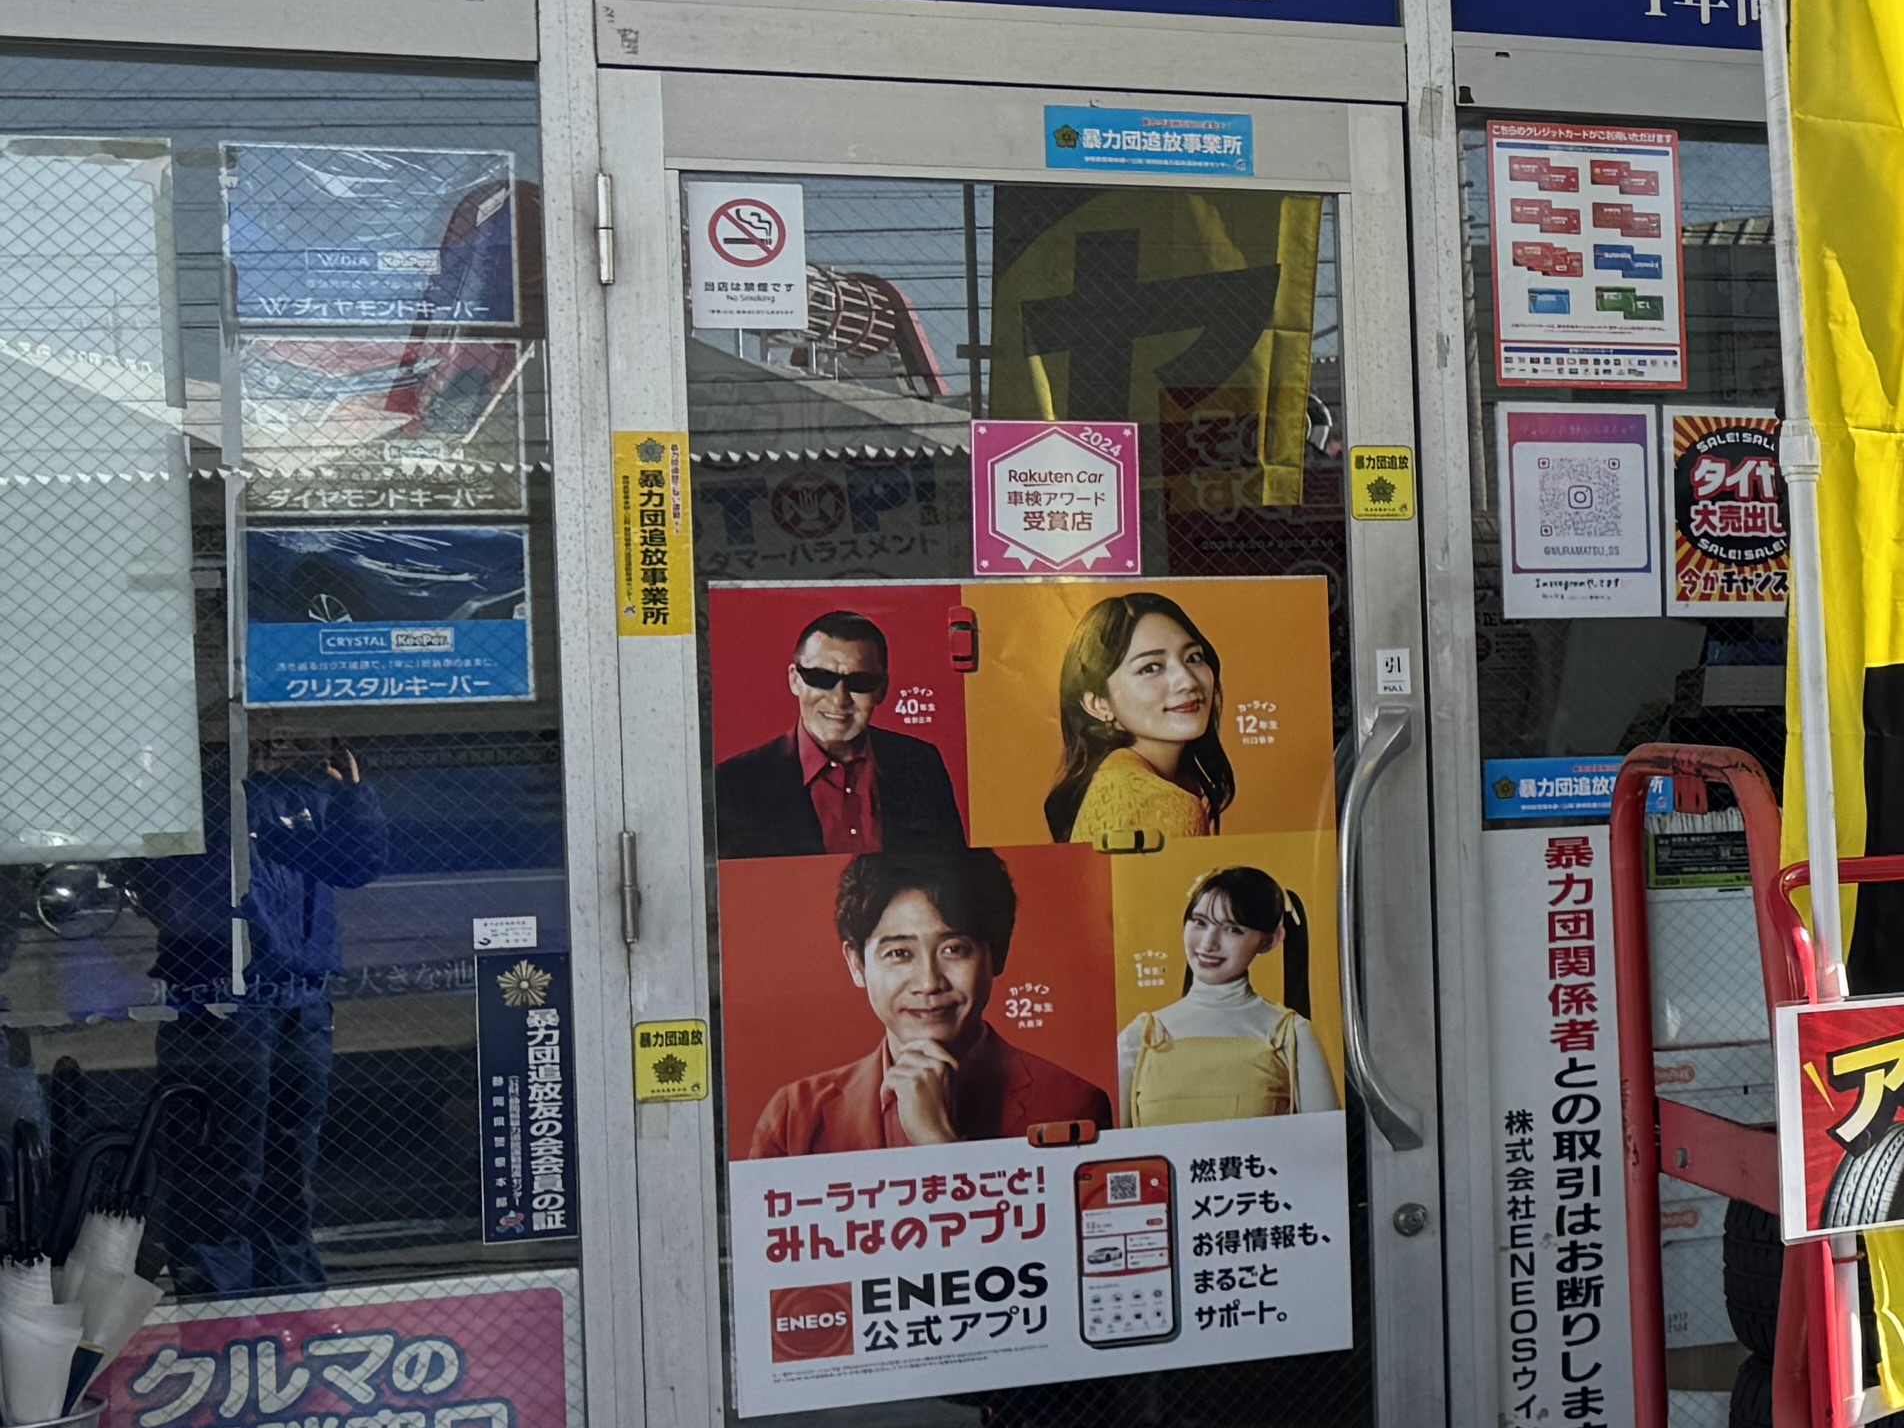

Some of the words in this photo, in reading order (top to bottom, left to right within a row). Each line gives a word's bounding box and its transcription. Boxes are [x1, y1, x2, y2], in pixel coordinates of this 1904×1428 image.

[1082, 128, 1243, 156] 暴力団追放事業所
[1077, 426, 1123, 458] 2024
[1007, 468, 1074, 487] Rakuten
[1076, 471, 1104, 485] Car
[1006, 489, 1106, 508] 車検アワード
[1022, 510, 1093, 533] 受賞店
[638, 469, 670, 626] 暴力団追放事業所
[325, 632, 387, 648] CRYSTAL
[1385, 655, 1401, 673] 引
[285, 674, 491, 699] クリスタルキーパー
[639, 1028, 704, 1049] 暴力団追放
[526, 1008, 567, 1232] 暴力団追放友の会会員の証
[1189, 1153, 1279, 1184] 燃費も、
[763, 1165, 1046, 1219] カーライフまるごと!
[1191, 1189, 1293, 1221] メンテも、
[765, 1199, 1047, 1264] みんなのアプリ
[1192, 1222, 1332, 1258] お得情報も、
[861, 1261, 1049, 1315] ENEOS
[1193, 1263, 1279, 1295] まるごと
[776, 1310, 848, 1333] ENEOS
[862, 1304, 1048, 1353] 公式アプリ
[1194, 1298, 1288, 1331] サポート。
[132, 1333, 460, 1428] クルマの
